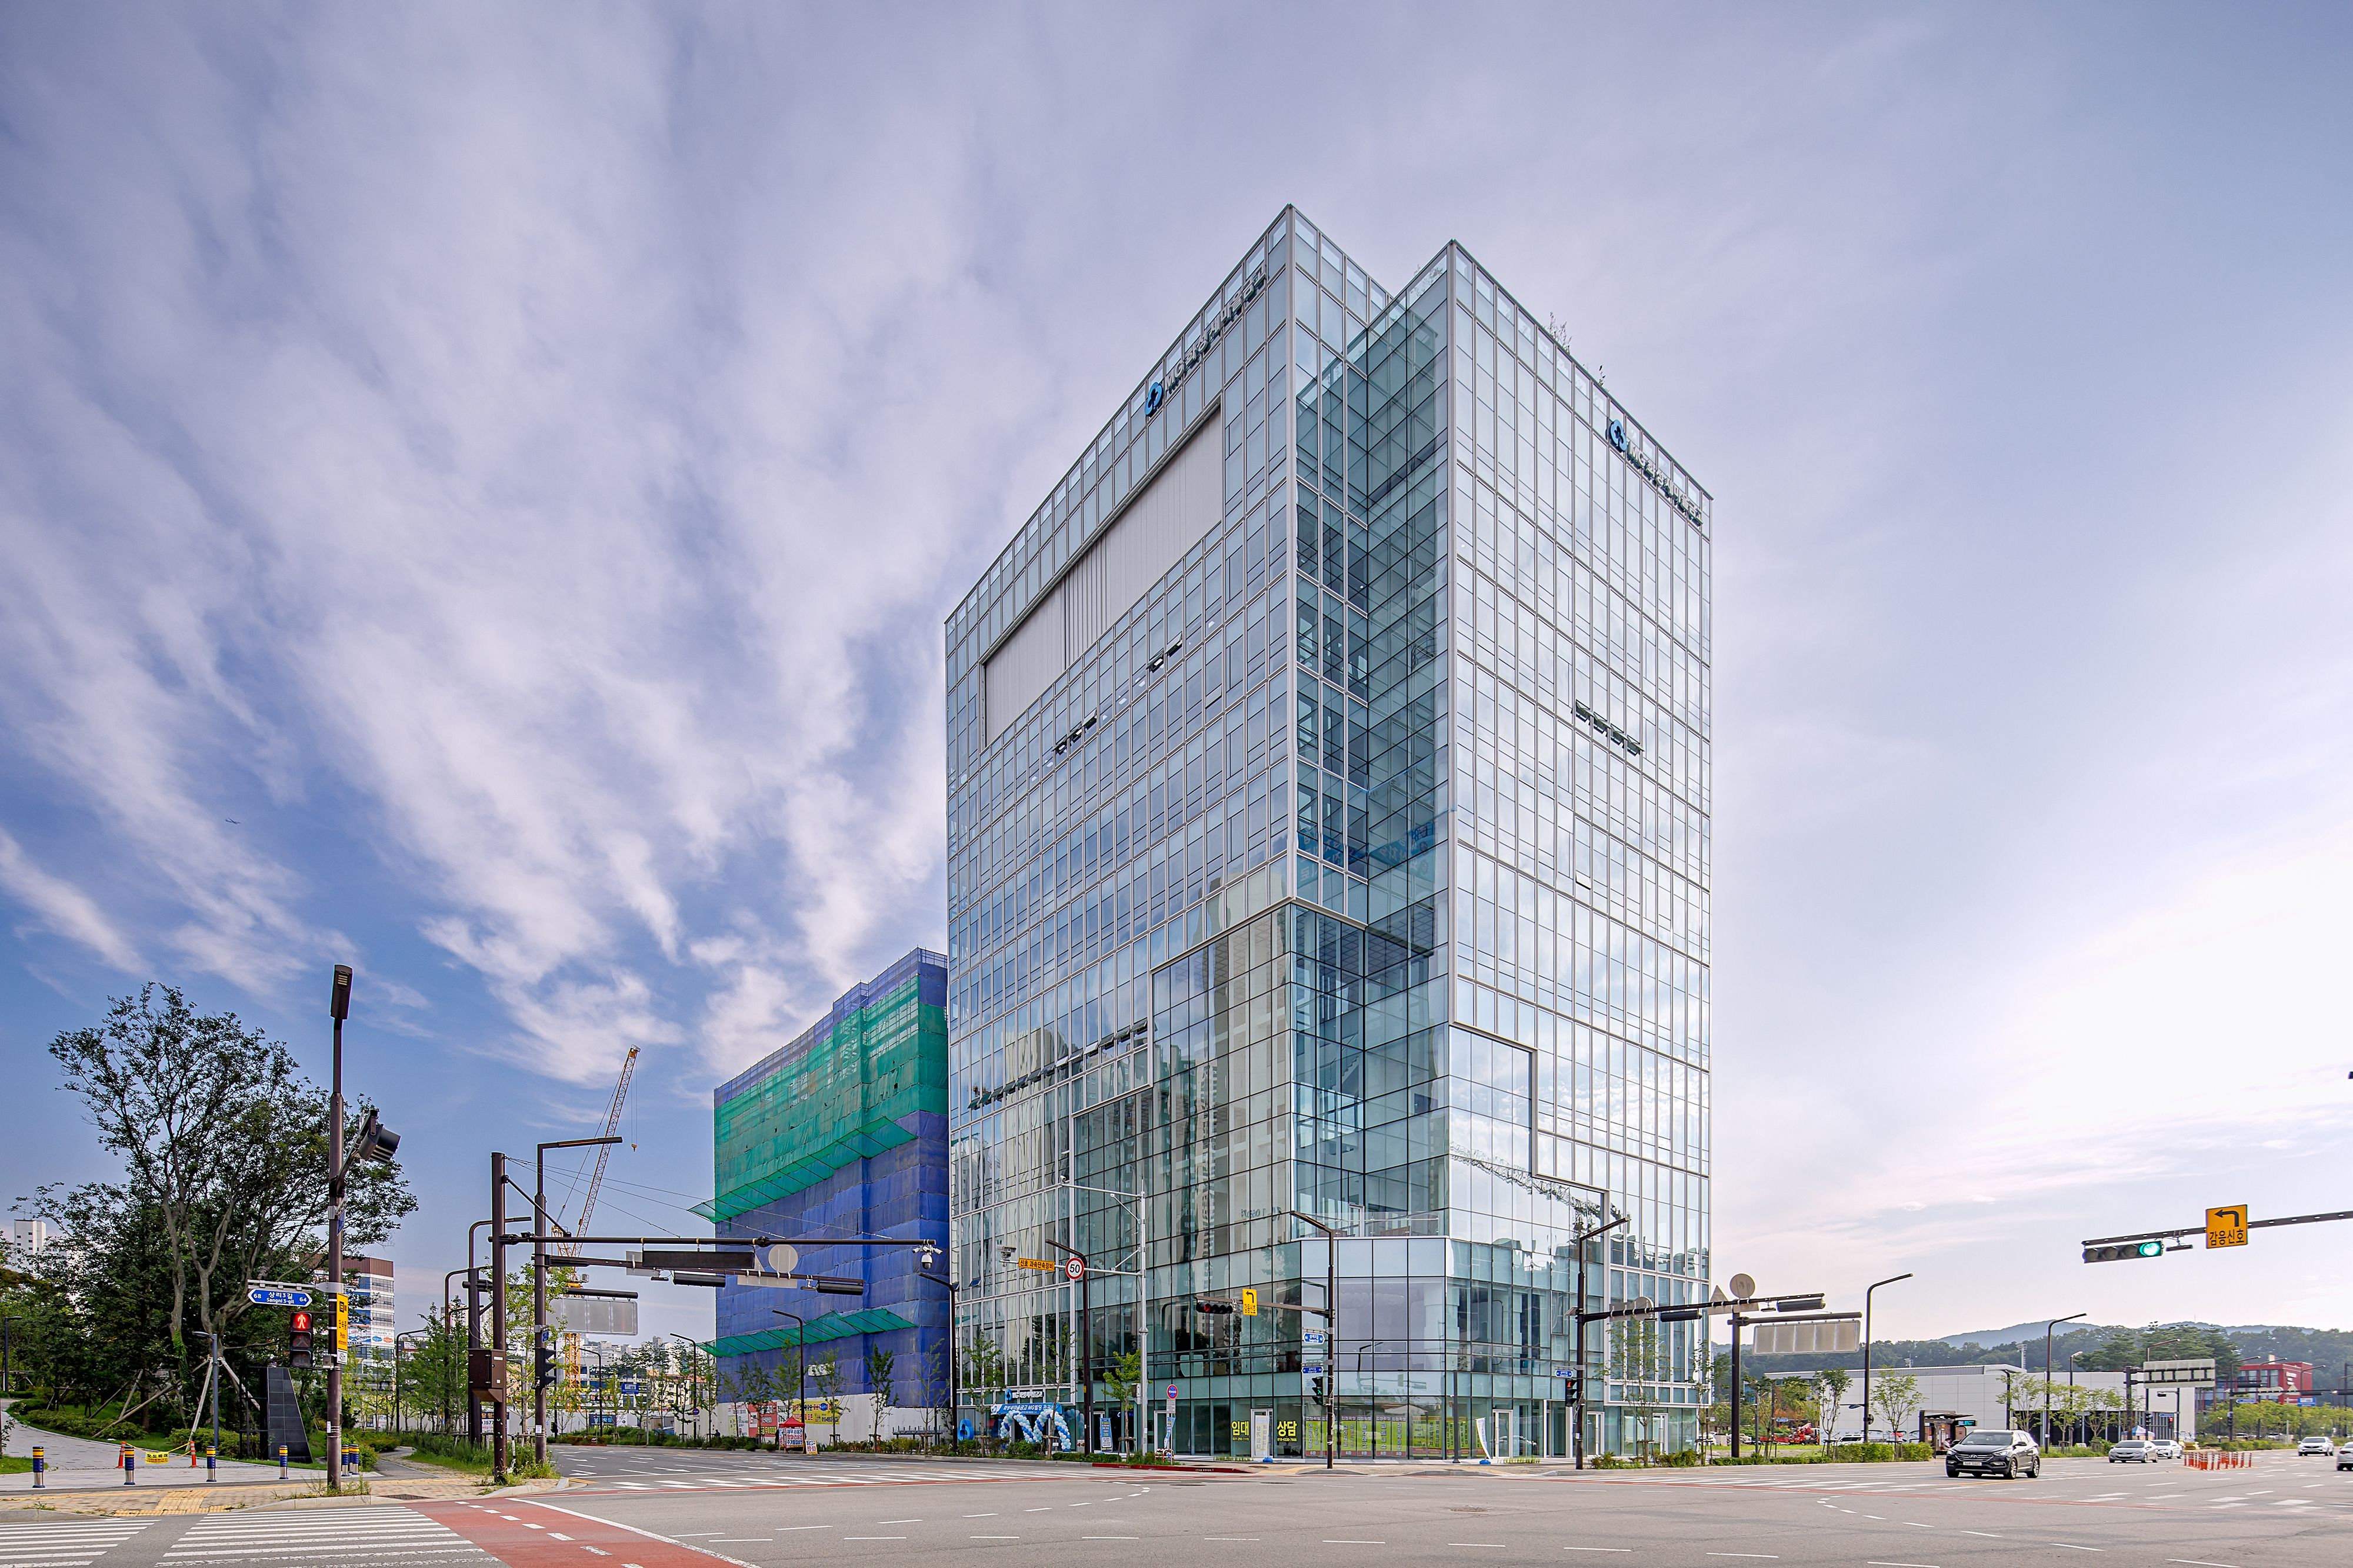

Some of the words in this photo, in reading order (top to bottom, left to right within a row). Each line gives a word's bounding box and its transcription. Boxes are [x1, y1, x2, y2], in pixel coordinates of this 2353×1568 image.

[2209, 1229, 2245, 1245] 감응신호
[1029, 1260, 1054, 1270] 과속단속장비
[1069, 1264, 1081, 1273] 50
[1244, 1303, 1256, 1314] 감응신호
[1231, 1420, 1249, 1436] 임대
[1277, 1420, 1297, 1437] 상담
